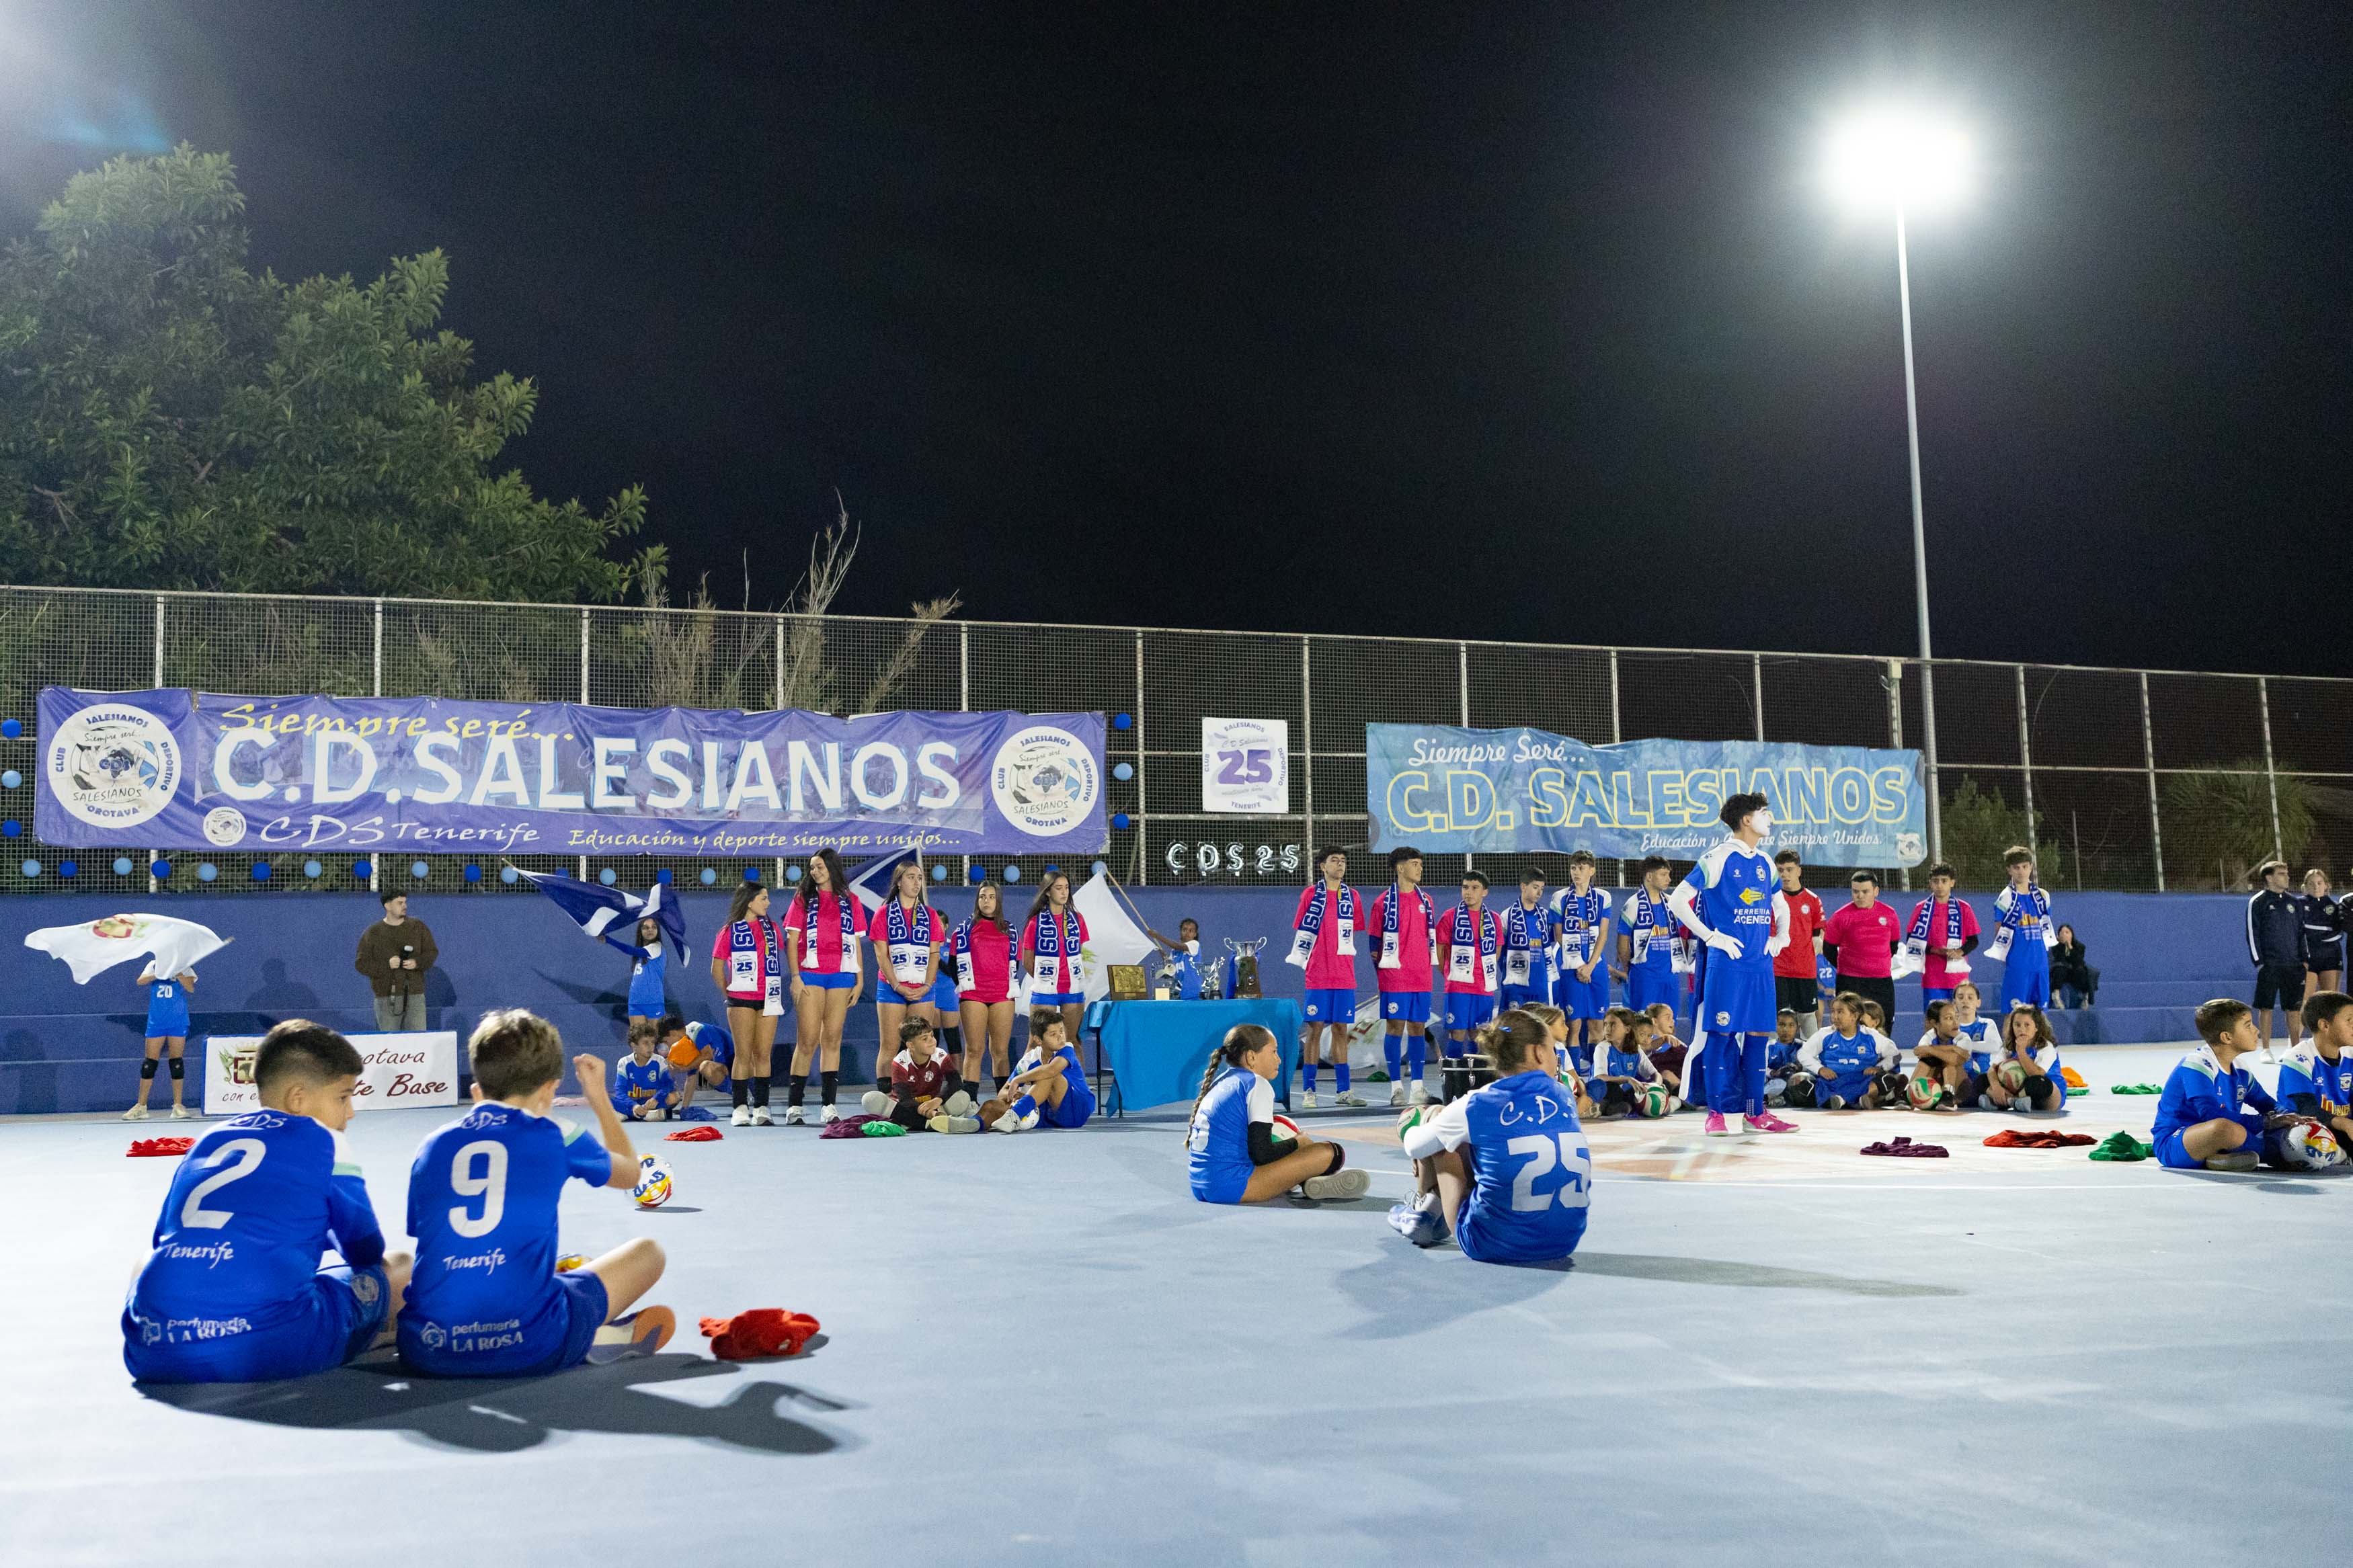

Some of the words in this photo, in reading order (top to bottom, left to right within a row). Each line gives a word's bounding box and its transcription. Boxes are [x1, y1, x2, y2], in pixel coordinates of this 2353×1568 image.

[86, 713, 149, 728] SALESIANOS
[1224, 722, 1265, 733] SALESIANOS
[220, 703, 431, 754] Siempre
[85, 733, 116, 743] Siempre
[1020, 735, 1071, 747] SALESIANOS
[56, 747, 66, 773] CLUB
[1408, 738, 1506, 770] Siempre
[161, 742, 173, 791] DEPORTIVO
[1218, 749, 1272, 785] 25
[1277, 747, 1286, 786] DEPORTIVO
[998, 768, 1006, 790] CLUB
[1081, 758, 1093, 802] DEPORTIVO
[73, 788, 143, 802] SALESIANOS
[1387, 770, 1514, 833] C.D.
[1014, 800, 1069, 814] SALESIANOS
[1231, 801, 1261, 809] TENERIFE
[568, 829, 685, 848] Educación
[692, 834, 707, 856] y
[713, 831, 788, 856] deporte
[793, 833, 870, 855] siempre
[1640, 833, 1707, 852] Educación
[1777, 829, 1829, 850] Siempre
[1298, 940, 1311, 950] 25
[1567, 943, 1581, 952] 25
[1908, 946, 1922, 956] 25
[892, 954, 907, 964] 25
[914, 956, 928, 966] 25
[1456, 955, 1470, 964] 25
[1511, 960, 1525, 968] 25
[737, 962, 752, 972] 25
[1039, 966, 1054, 976] 25
[1486, 964, 1494, 974] 25
[1819, 967, 1833, 979] 22
[156, 985, 173, 999] 20
[770, 987, 781, 996] 25
[387, 1073, 448, 1097] Base
[222, 1092, 244, 1102] con
[1507, 1132, 1591, 1212] 25
[181, 1138, 267, 1229] 2
[448, 1140, 508, 1238] 9
[164, 1242, 235, 1269] Tenerife
[442, 1247, 506, 1276] Tenerife
[452, 1338, 473, 1352] LA
[478, 1331, 523, 1350] ROSA
